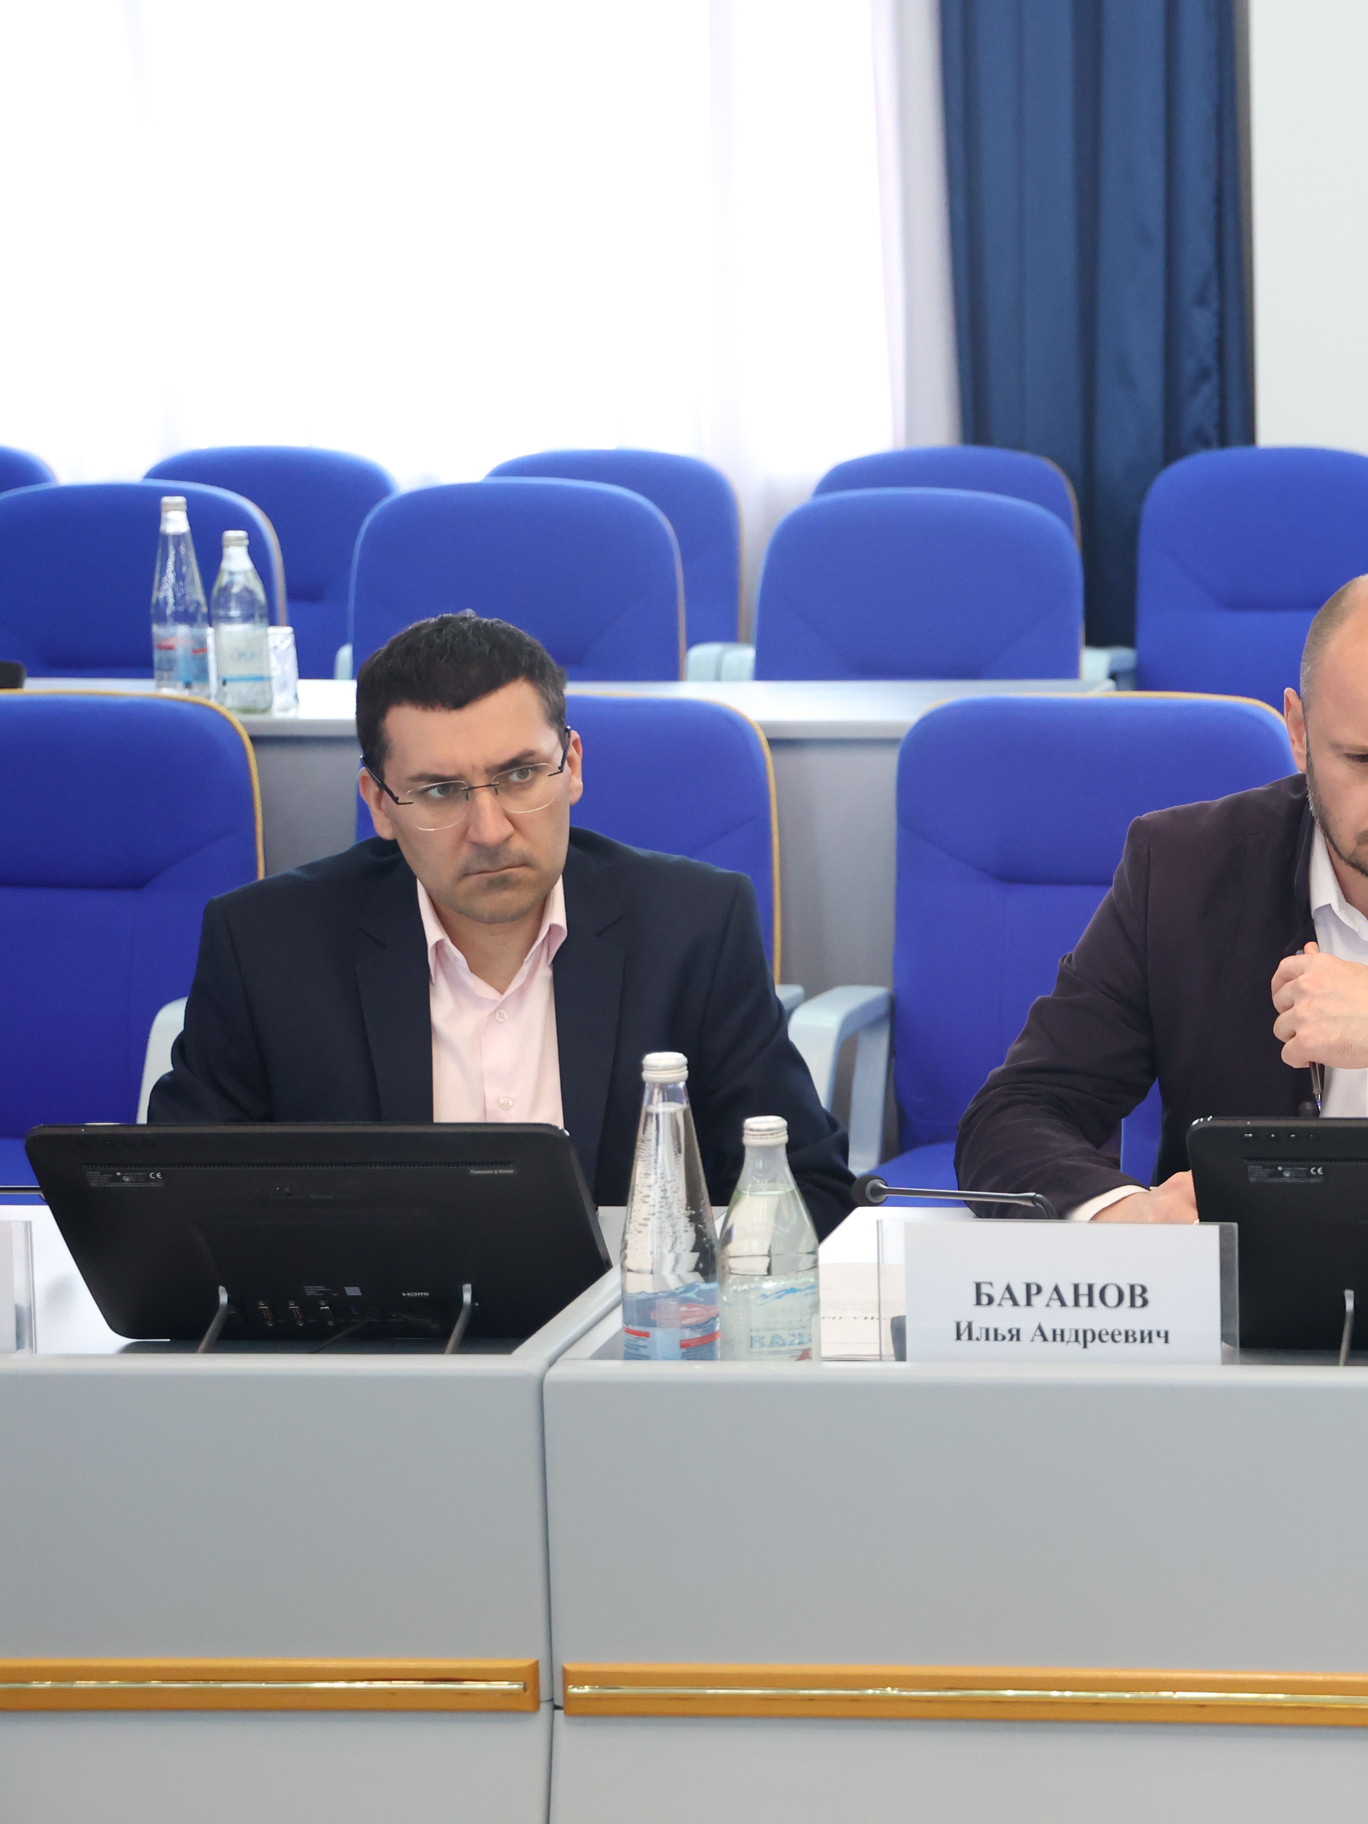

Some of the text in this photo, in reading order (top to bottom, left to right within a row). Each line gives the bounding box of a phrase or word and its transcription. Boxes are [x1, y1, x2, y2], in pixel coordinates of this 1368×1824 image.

[974, 1281, 1149, 1309] БАРАНОВ
[954, 1321, 1170, 1349] Илья Андреевич
